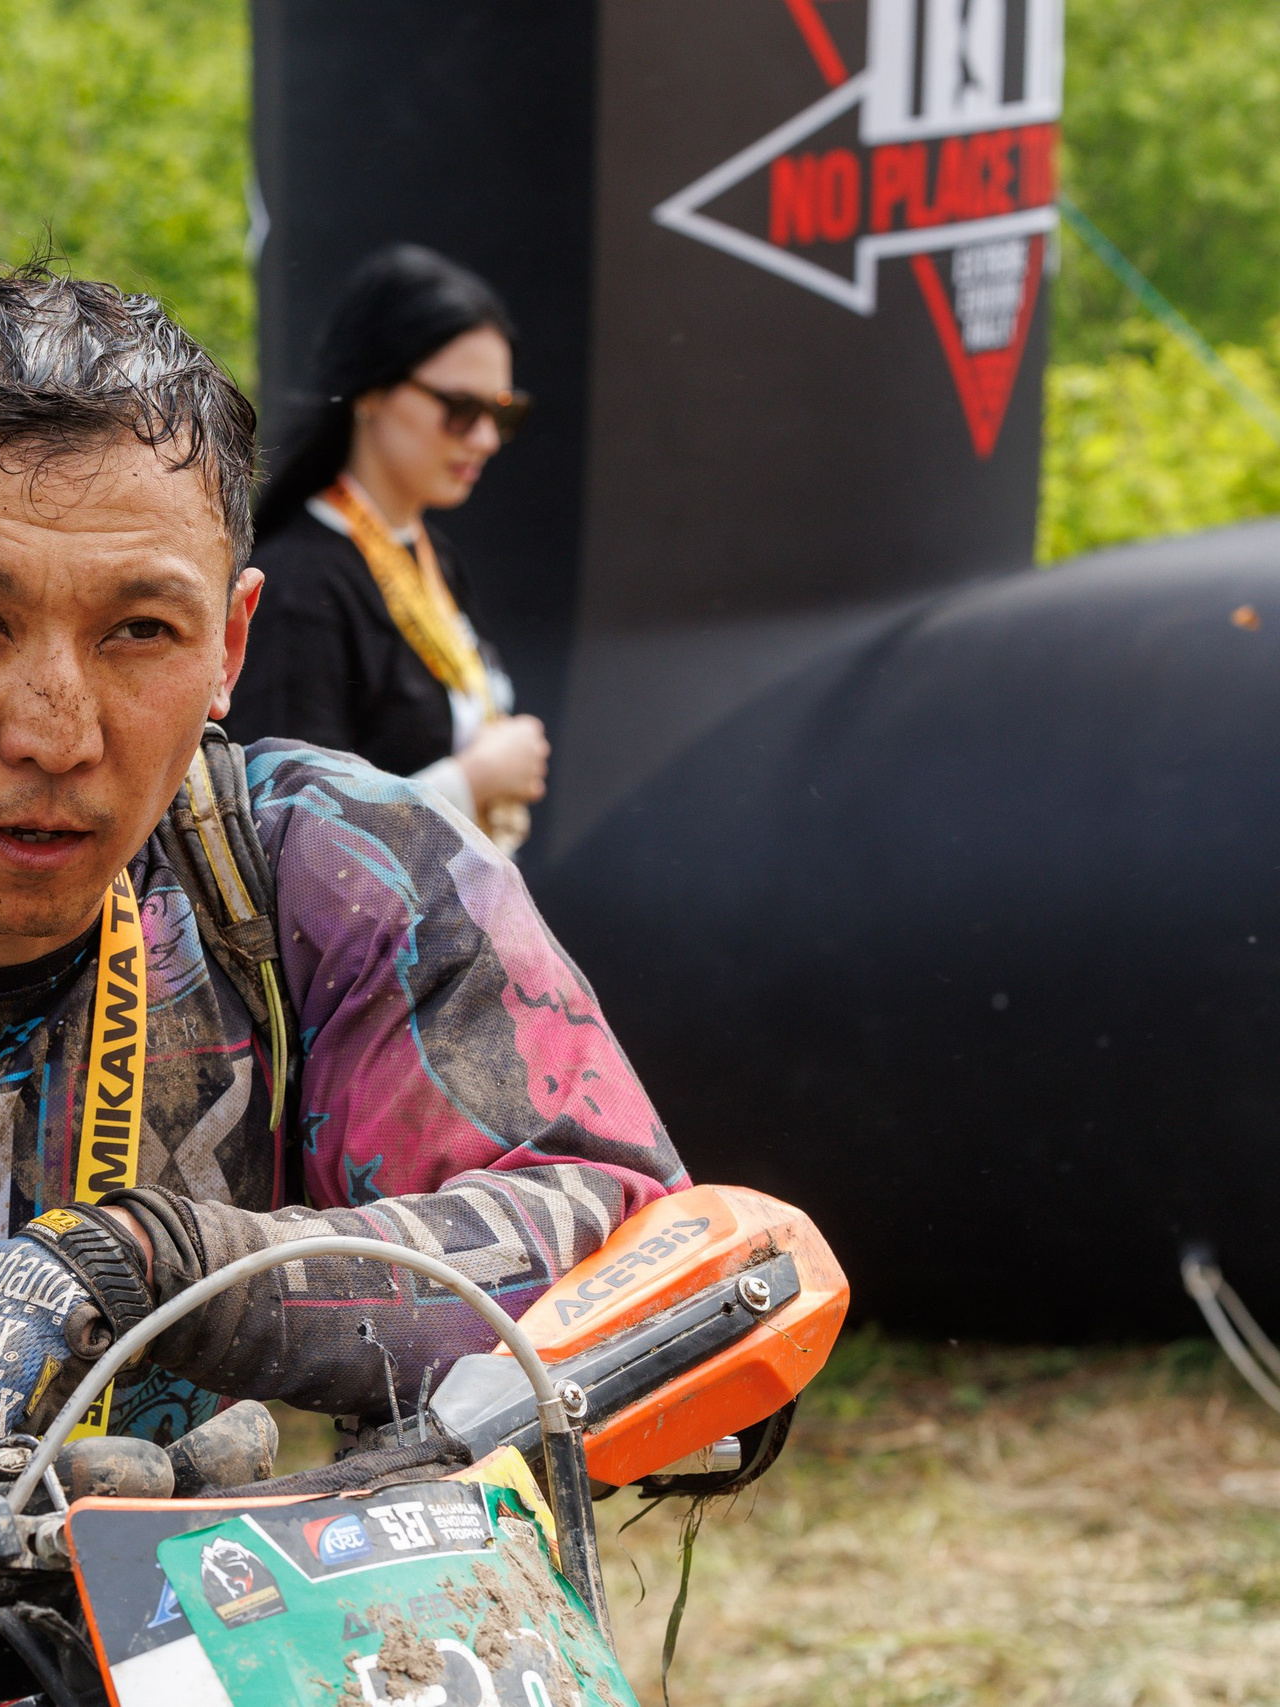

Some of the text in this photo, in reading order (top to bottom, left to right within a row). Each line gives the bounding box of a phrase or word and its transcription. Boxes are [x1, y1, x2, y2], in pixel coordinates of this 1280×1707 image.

[770, 147, 859, 247] NO
[871, 128, 1014, 236] PLACE
[88, 866, 139, 1194] MIKAWA TE
[427, 1502, 482, 1516] SAKHALIN
[433, 1515, 480, 1528] ENDURO
[439, 1527, 486, 1541] TROPHY
